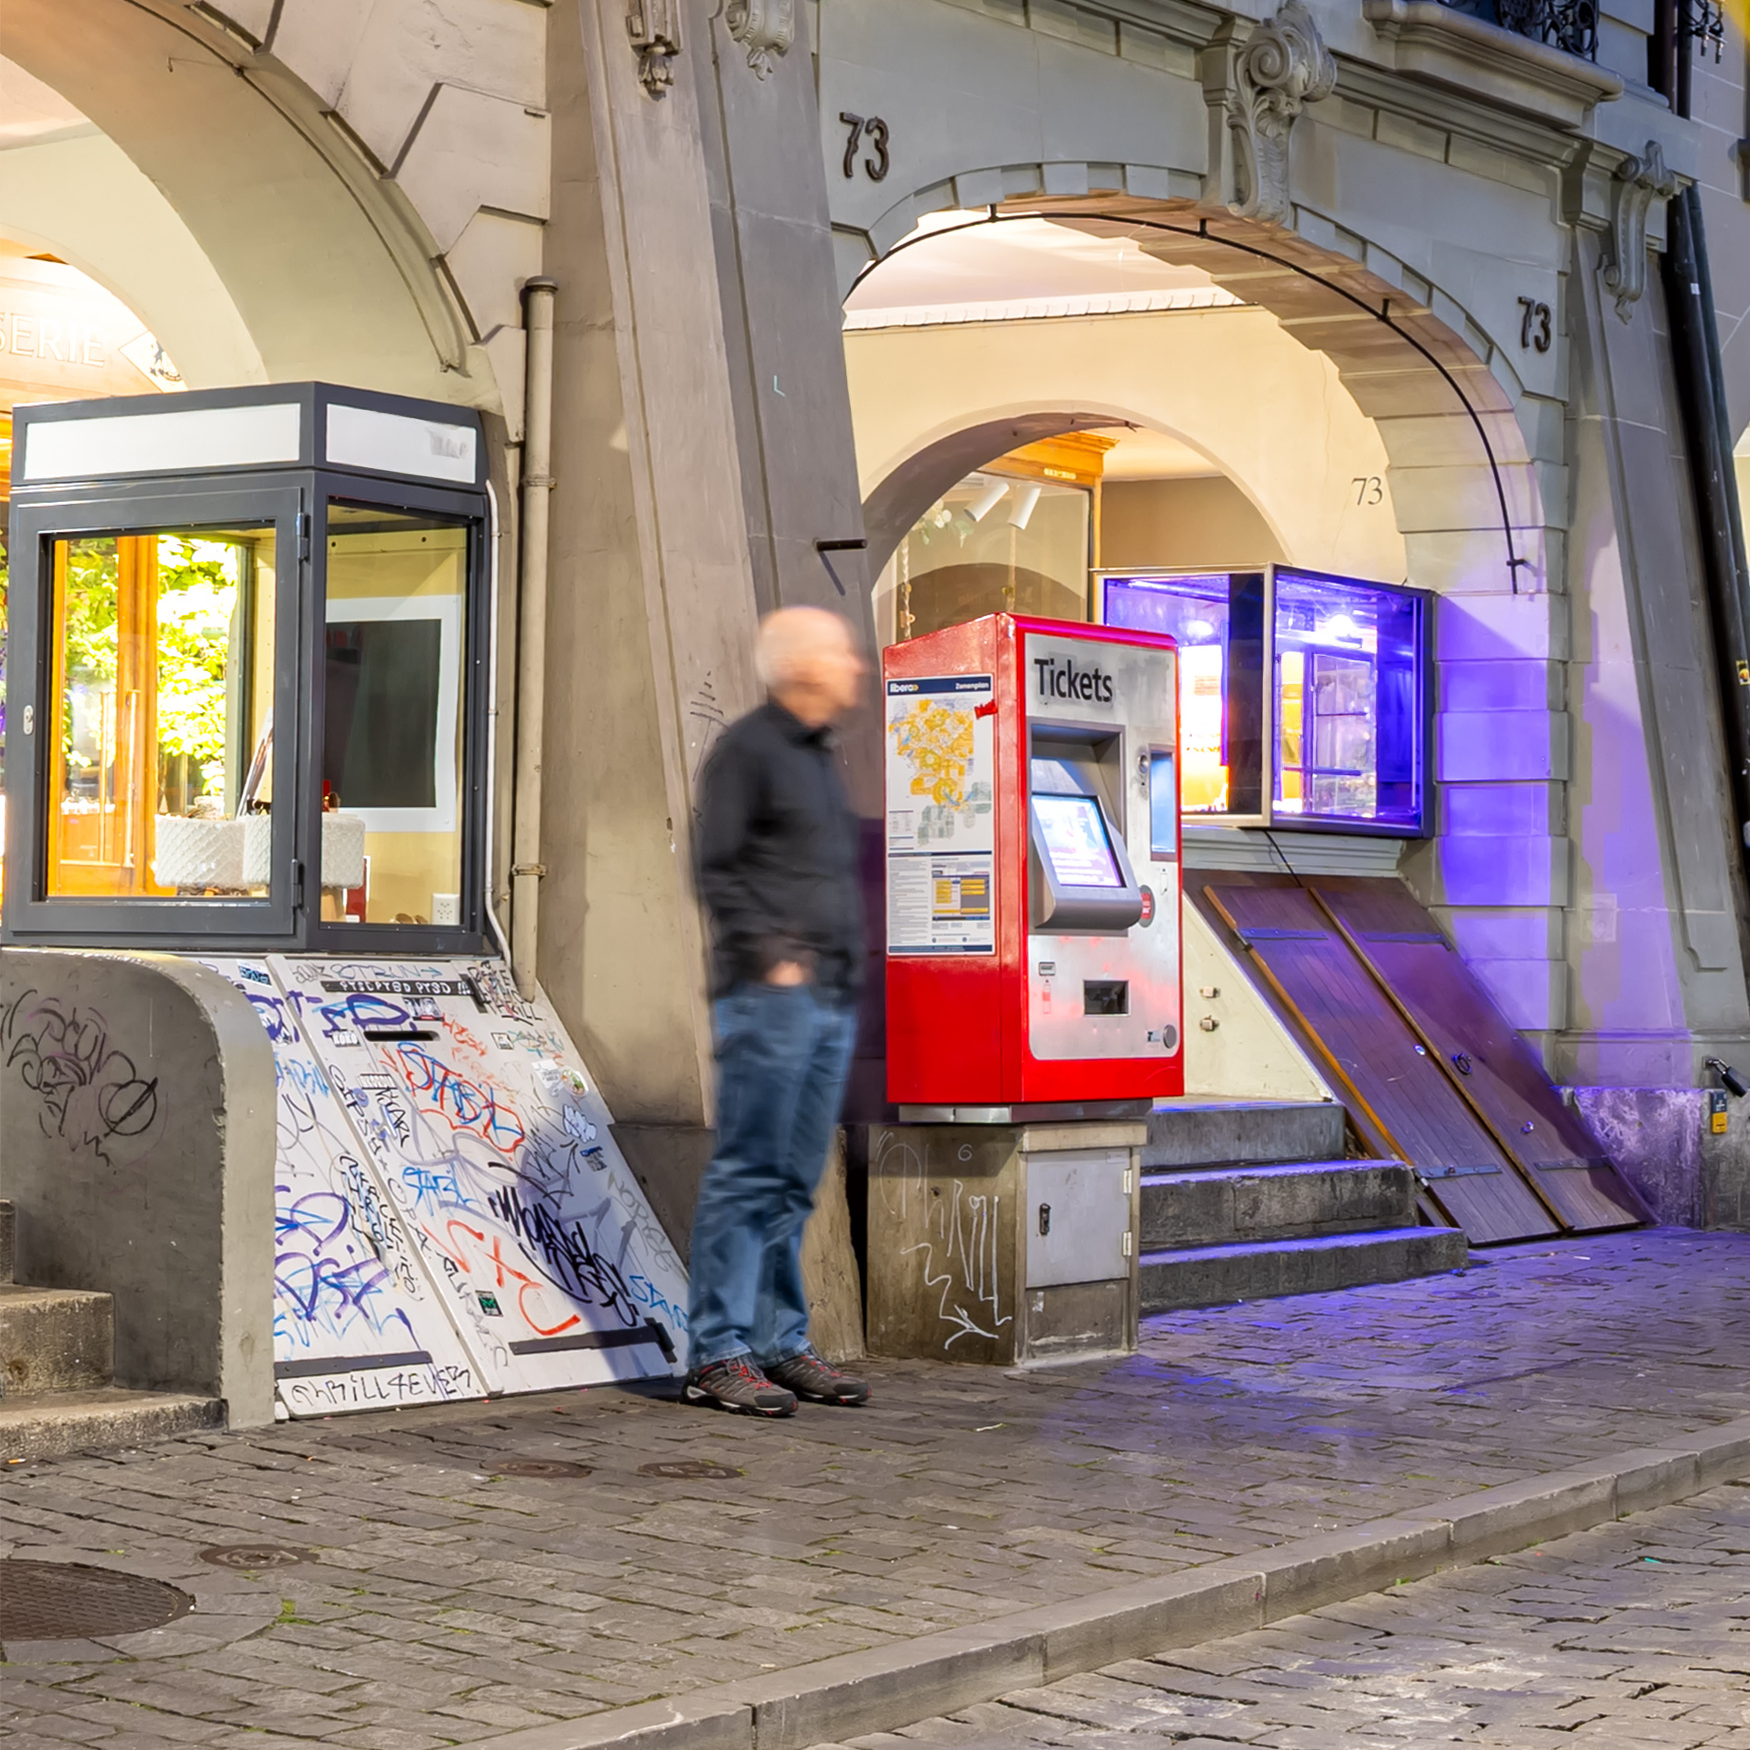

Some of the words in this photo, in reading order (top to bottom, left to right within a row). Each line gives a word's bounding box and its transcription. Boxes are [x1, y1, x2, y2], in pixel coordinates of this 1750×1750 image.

[839, 111, 890, 183] 73
[0, 311, 106, 368] ERIE
[1517, 295, 1551, 354] 73
[1351, 475, 1384, 506] 73
[1033, 657, 1114, 704] Tickets
